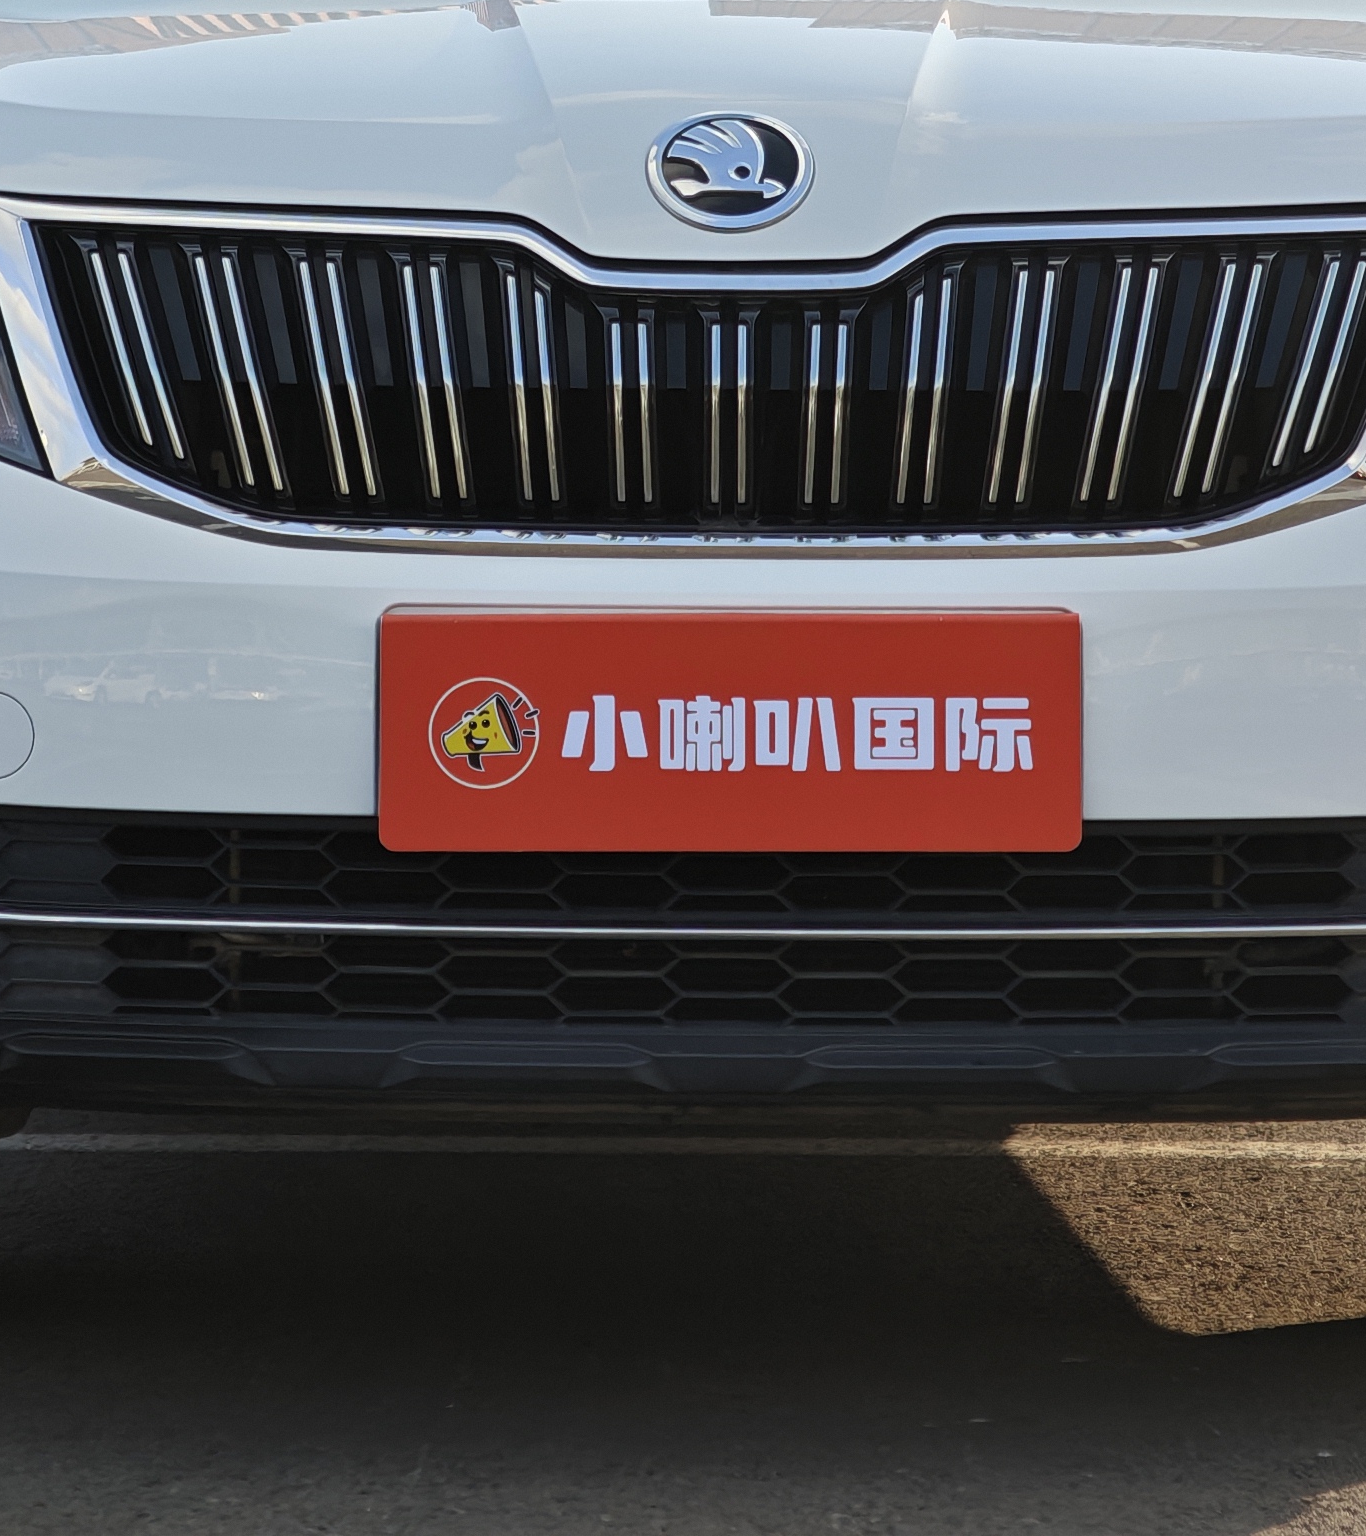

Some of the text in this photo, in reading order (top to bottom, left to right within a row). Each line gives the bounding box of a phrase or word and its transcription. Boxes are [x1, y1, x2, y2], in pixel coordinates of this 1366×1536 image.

[561, 694, 1034, 773] 小喇叭国际
